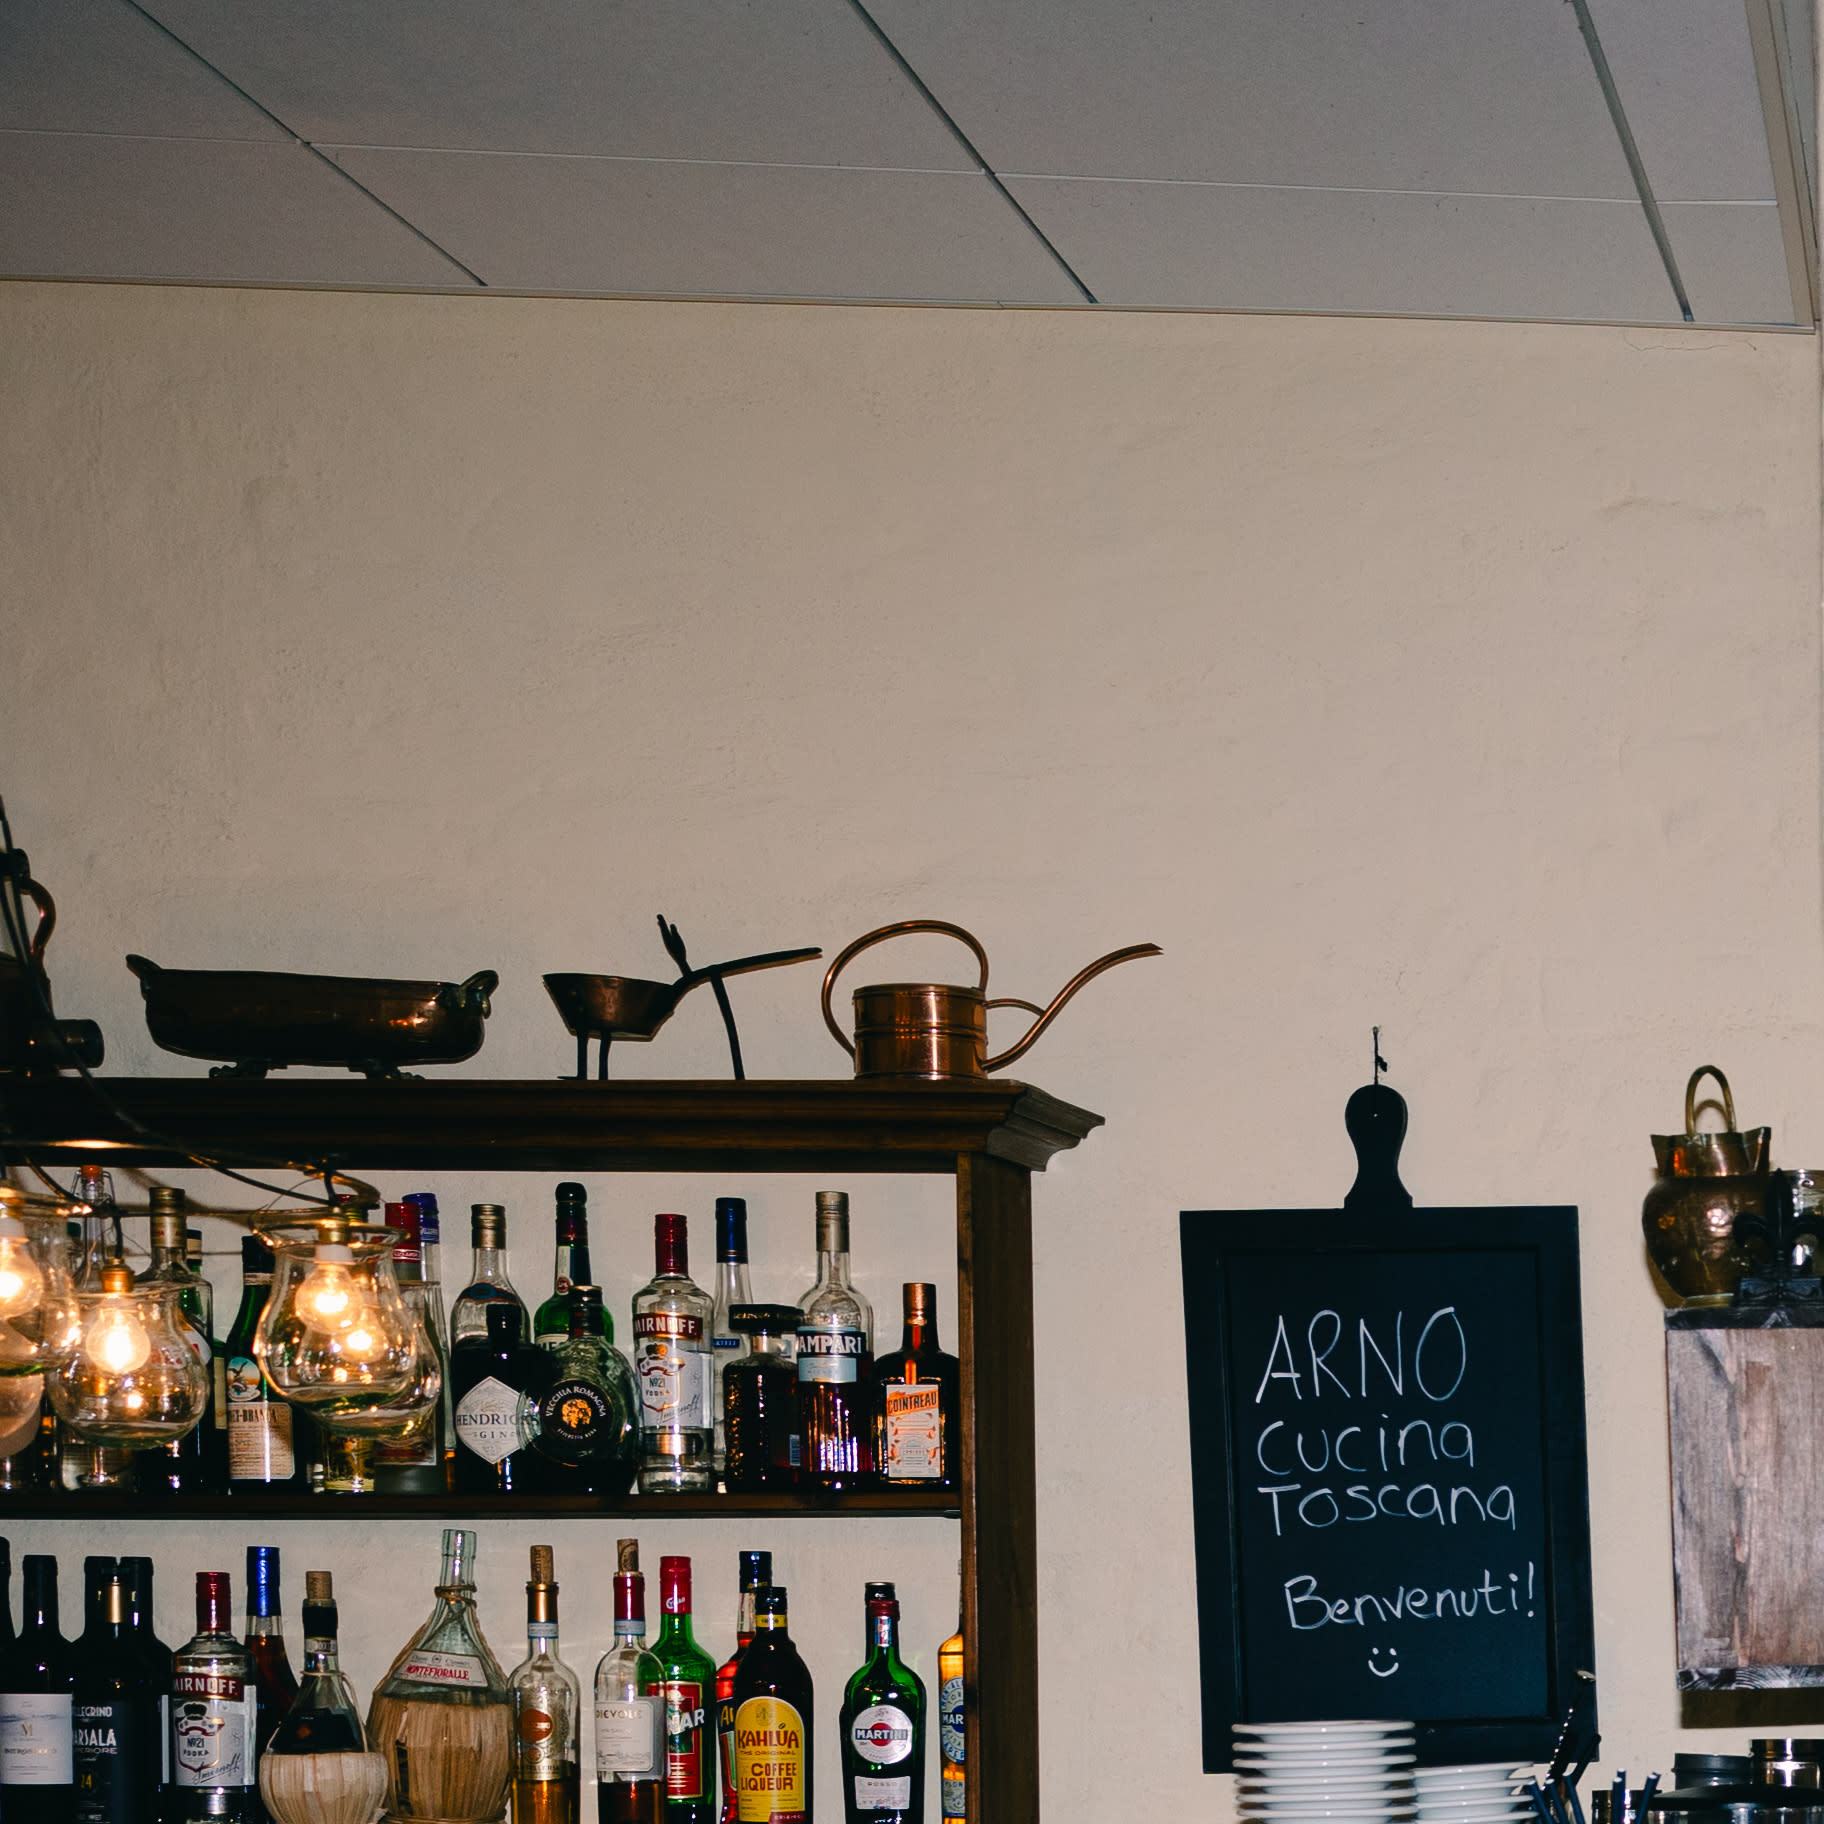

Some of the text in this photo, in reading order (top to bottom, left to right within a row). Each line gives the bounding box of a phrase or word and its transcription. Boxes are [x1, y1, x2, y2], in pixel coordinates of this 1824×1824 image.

[799, 1334, 862, 1354] AMPARI
[1255, 1306, 1467, 1404] ARNO
[888, 1391, 937, 1413] COINTREAU
[1257, 1482, 1516, 1537] Toscana
[1283, 1561, 1536, 1631] Benvenuti!
[175, 1678, 237, 1694] MIRNOFF
[856, 1729, 908, 1740] MARTINI
[751, 1762, 797, 1777] COFFEE
[740, 1777, 793, 1792] LIQUEUR
